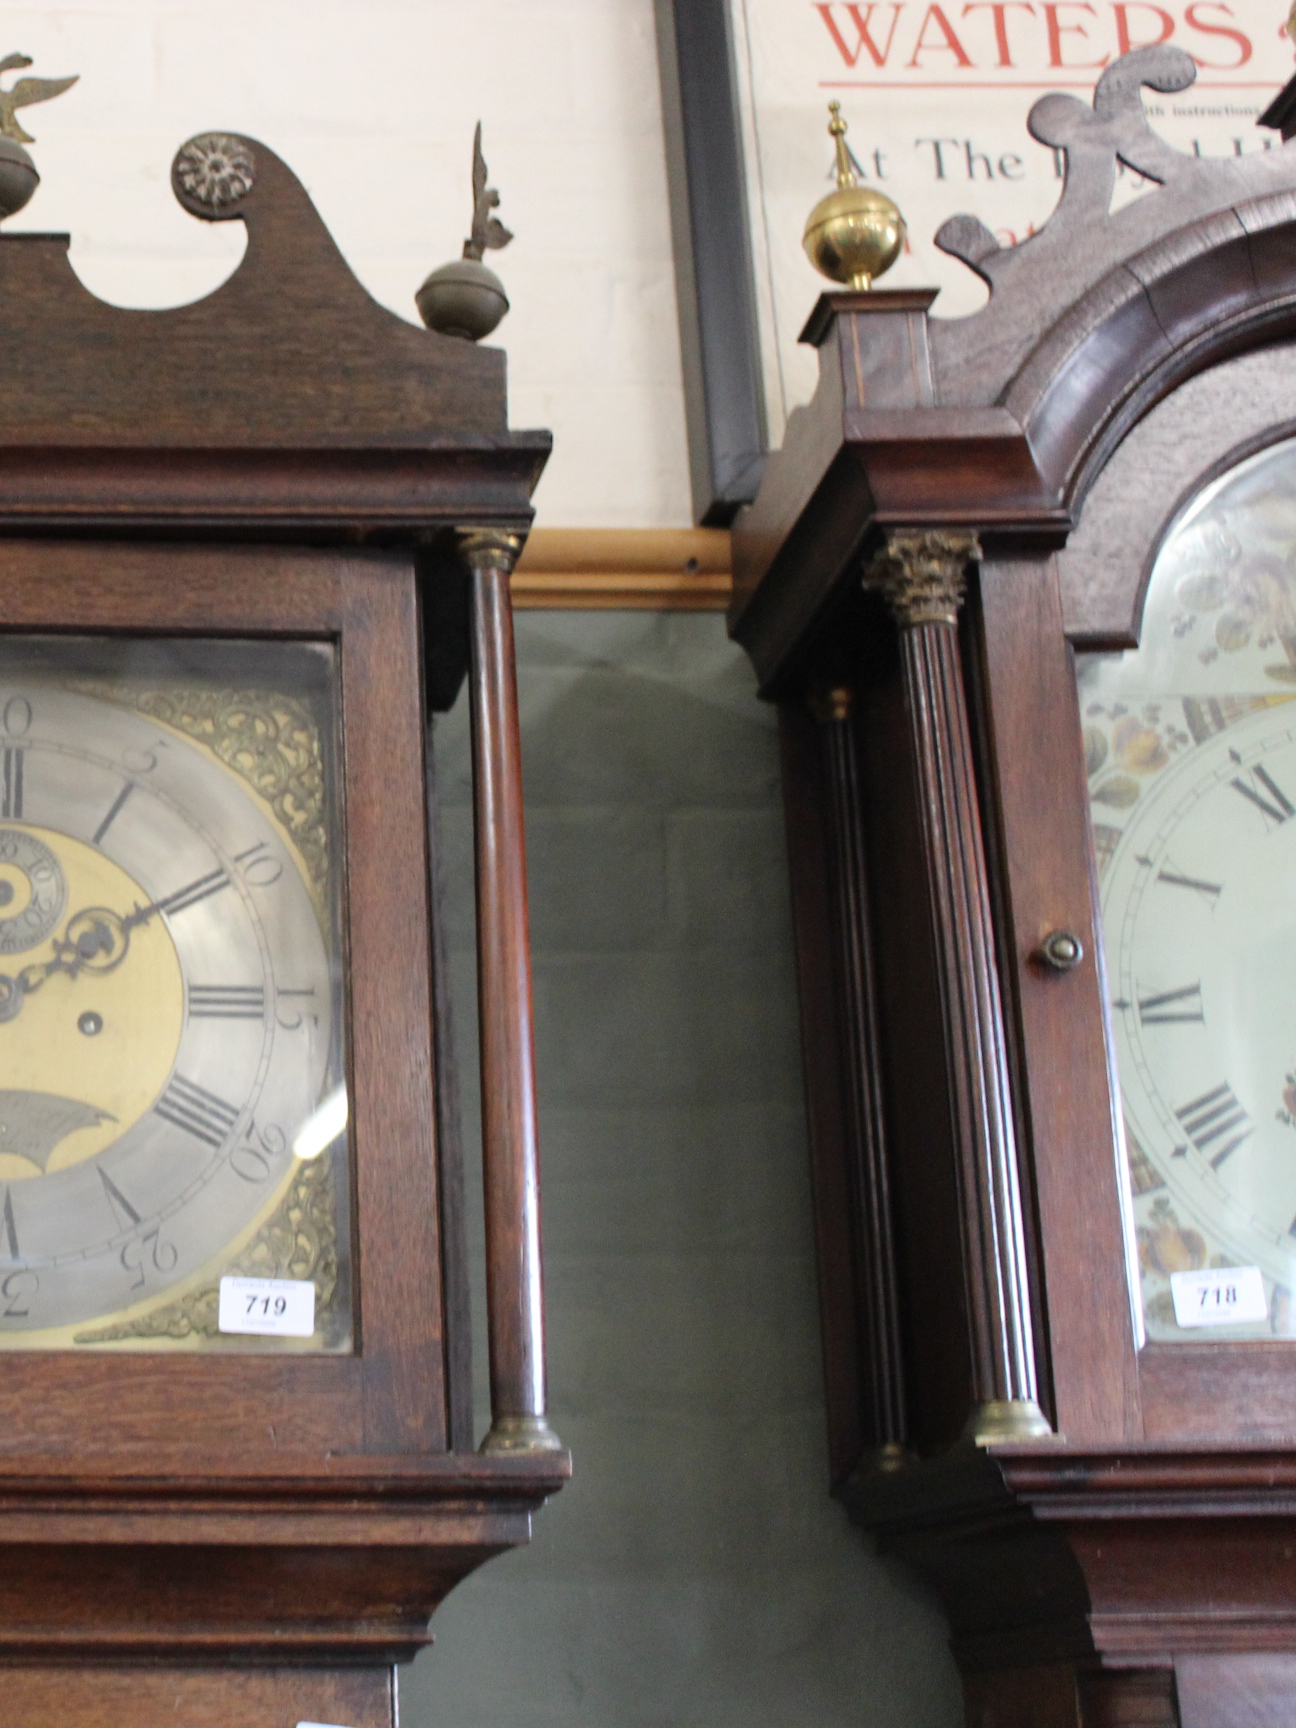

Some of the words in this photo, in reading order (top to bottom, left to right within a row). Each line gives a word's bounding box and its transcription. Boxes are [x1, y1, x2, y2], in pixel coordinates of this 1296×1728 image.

[913, 138, 1026, 182] The
[233, 842, 285, 888] 10
[276, 986, 319, 1031] 15
[229, 1119, 287, 1184] 20
[120, 1227, 179, 1293] 25
[246, 1294, 287, 1317] 719
[1197, 1283, 1238, 1306] 718
